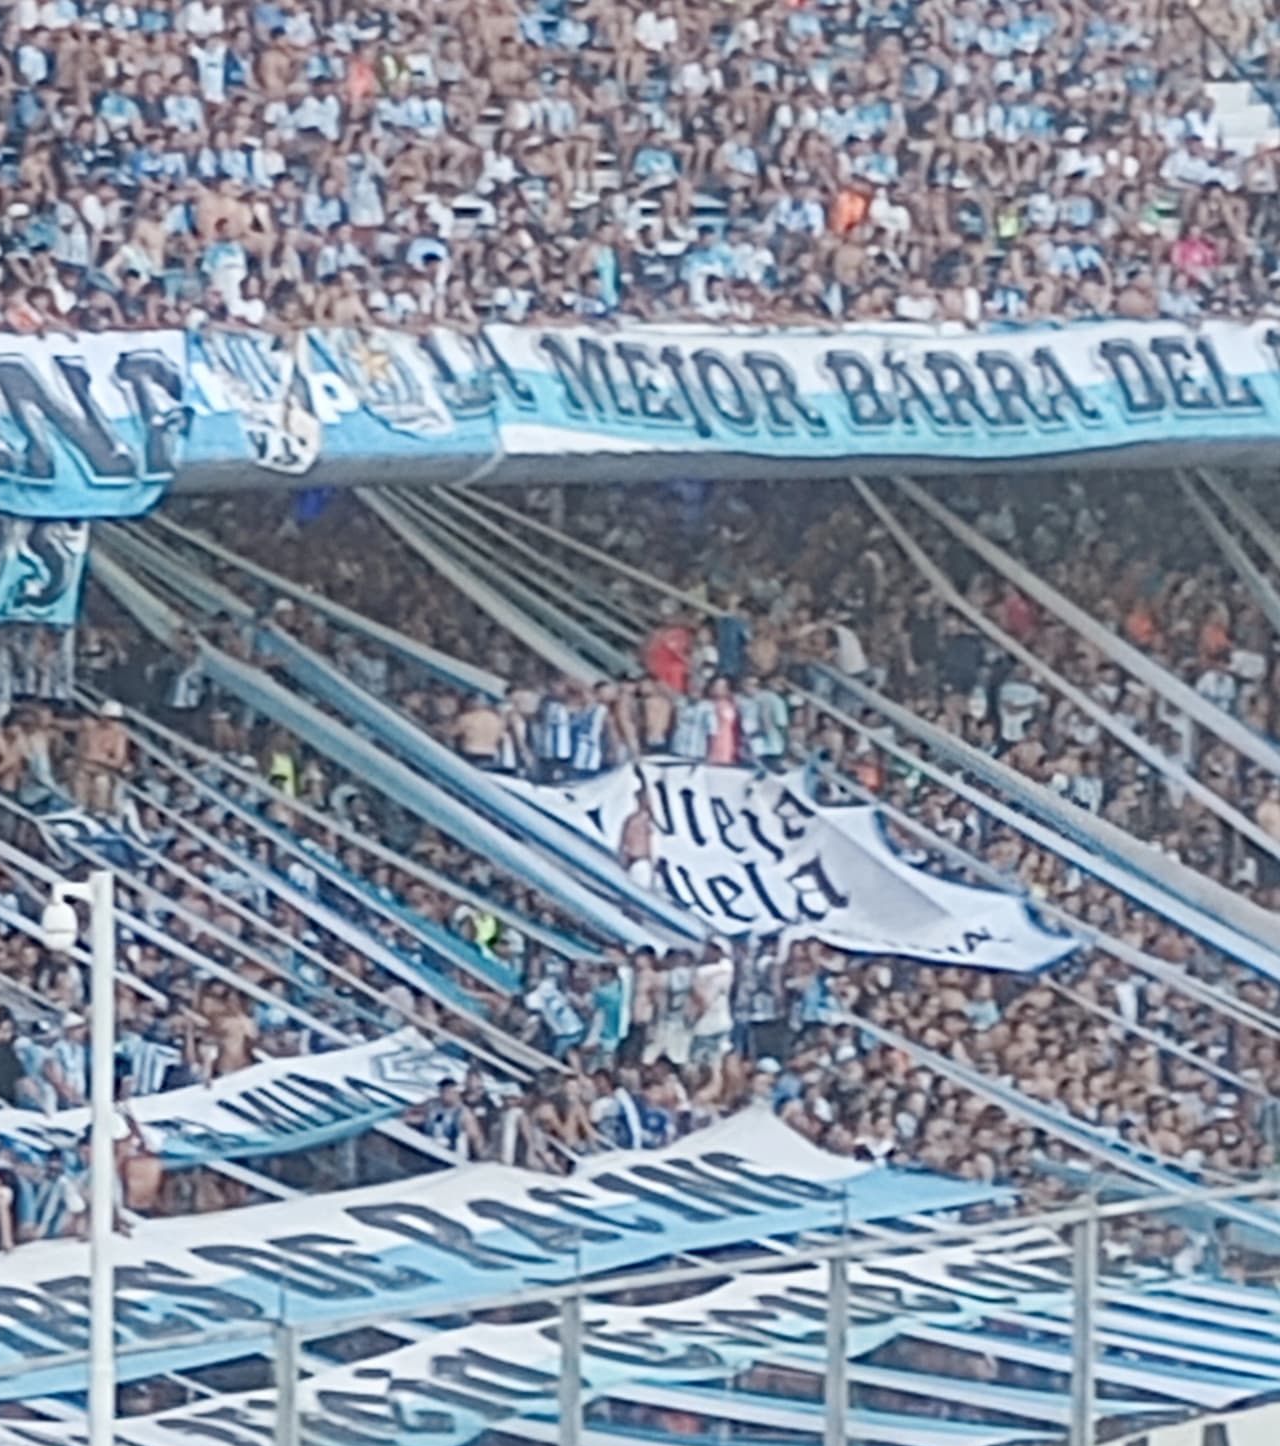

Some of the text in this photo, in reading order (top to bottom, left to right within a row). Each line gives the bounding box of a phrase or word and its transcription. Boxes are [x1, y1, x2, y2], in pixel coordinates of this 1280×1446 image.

[538, 333, 830, 438] MEJOR
[822, 345, 1104, 434] BARRA
[1097, 334, 1264, 418] DEL
[188, 1230, 444, 1302] DE
[343, 1150, 838, 1274] RACING
